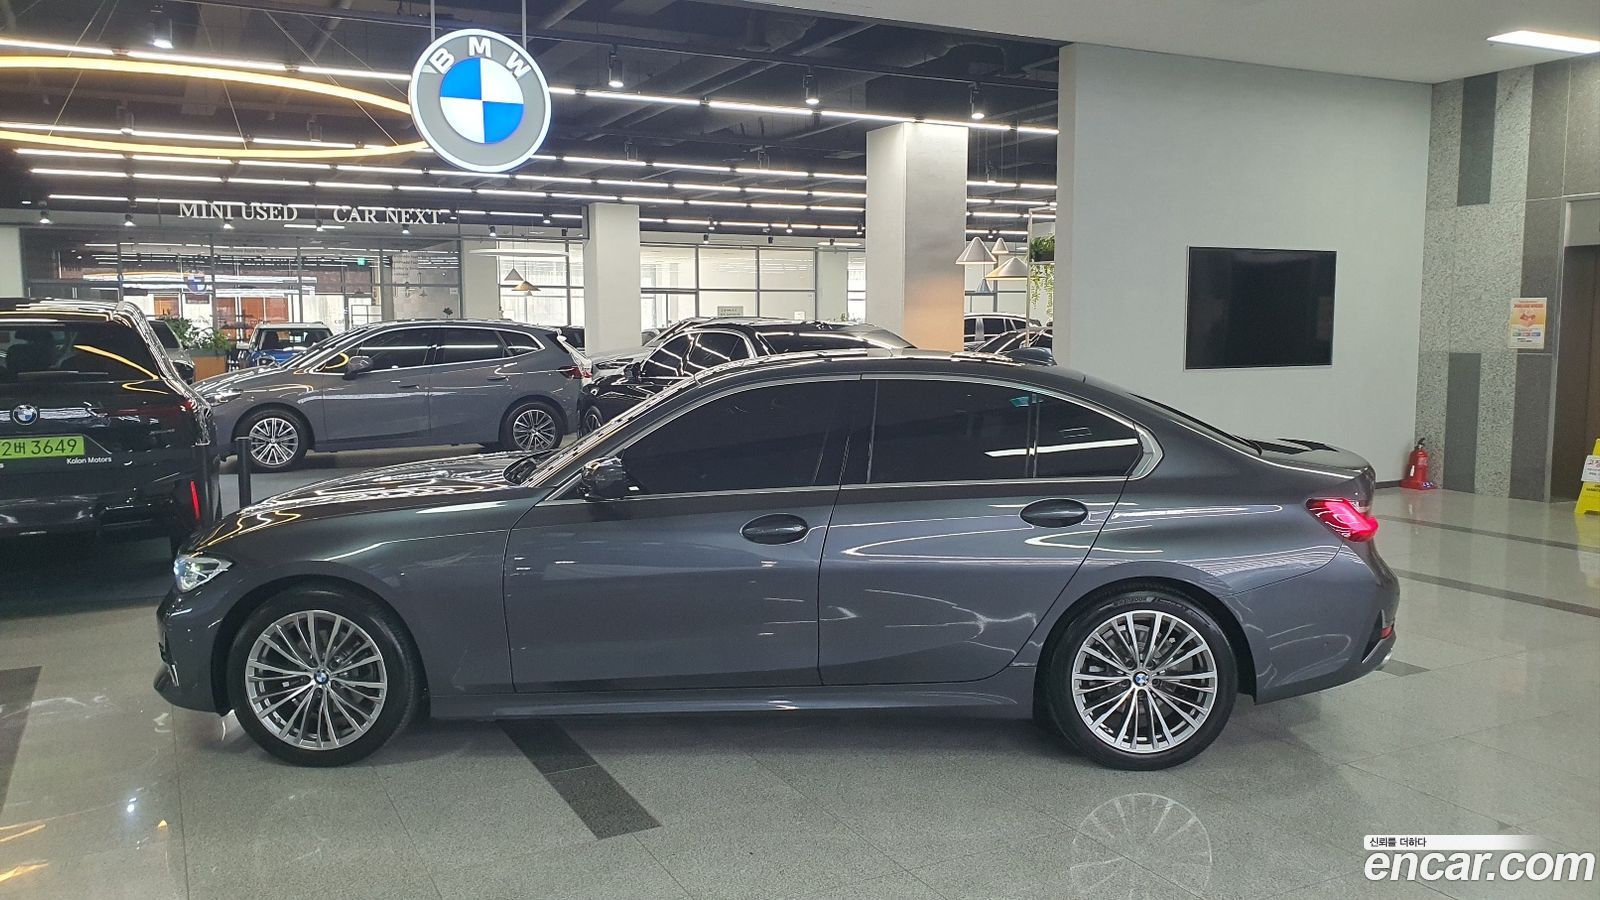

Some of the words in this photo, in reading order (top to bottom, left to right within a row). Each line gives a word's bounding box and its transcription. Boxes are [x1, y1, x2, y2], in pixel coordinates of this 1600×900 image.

[429, 36, 532, 79] BMW
[178, 202, 234, 219] MINI
[241, 203, 298, 221] USED
[333, 206, 379, 224] CAR
[384, 208, 446, 225] NEXT.
[31, 438, 77, 455] 3649
[66, 457, 87, 465] Kolon
[88, 456, 112, 464] Motors
